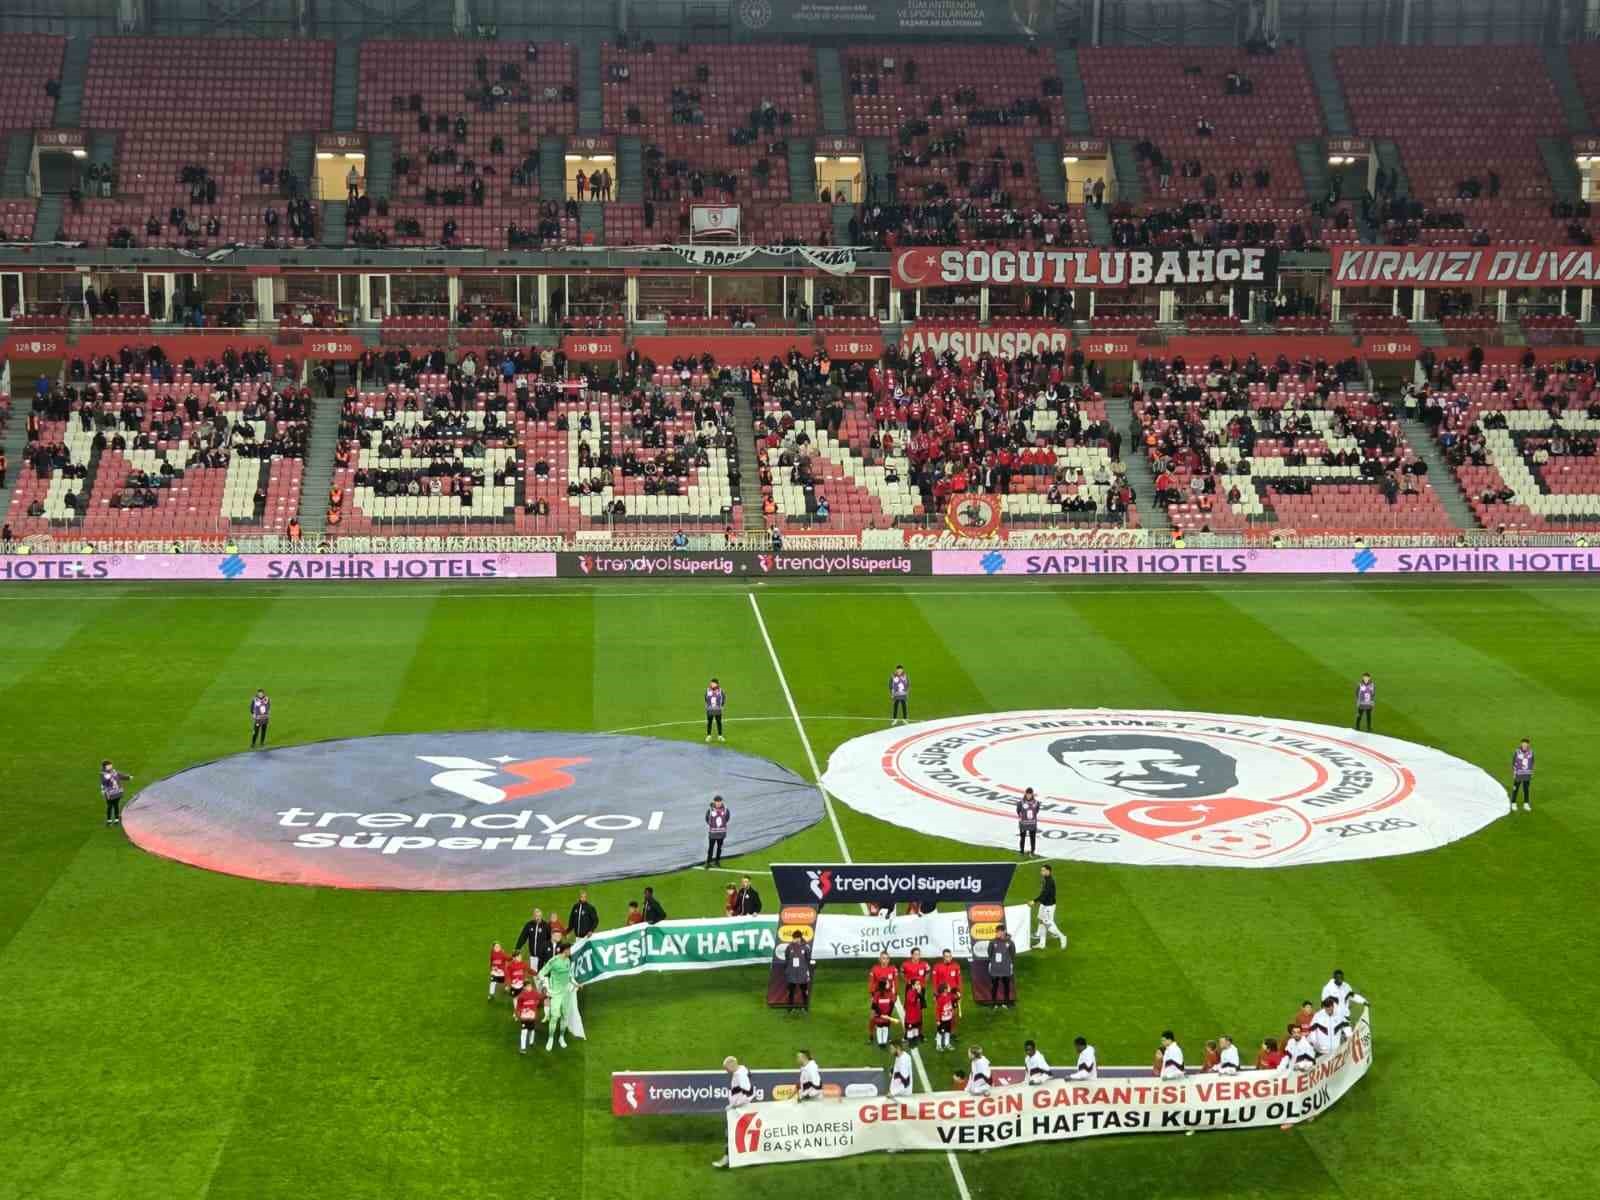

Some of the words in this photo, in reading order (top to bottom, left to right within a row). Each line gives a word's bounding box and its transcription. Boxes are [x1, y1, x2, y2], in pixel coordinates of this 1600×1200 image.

[941, 248, 1266, 285] SOGUTLUBAHCE
[1337, 250, 1482, 281] KIRMIZI
[384, 558, 497, 578] HOTELS
[596, 555, 672, 573] trendyol
[775, 553, 850, 573] trendyol
[1137, 554, 1247, 573] HOTELS
[1024, 718, 1196, 730] MEHMET
[1269, 735, 1367, 768] YILMAZ
[1302, 768, 1373, 808] SEZONU
[275, 807, 664, 835] trendyol
[1325, 817, 1418, 838] 2026
[834, 874, 916, 895] trendyol
[597, 930, 694, 967] YEŞİLAY
[831, 934, 930, 957] Yeşilaycısın
[648, 1084, 713, 1101] trendyol
[763, 1124, 799, 1139] GELİR
[936, 1115, 1022, 1144] VERGİ
[1032, 1110, 1150, 1135] HAFTASI
[1161, 1105, 1256, 1127] KUTLU
[763, 1135, 854, 1153] BAŞKANLIĞI
